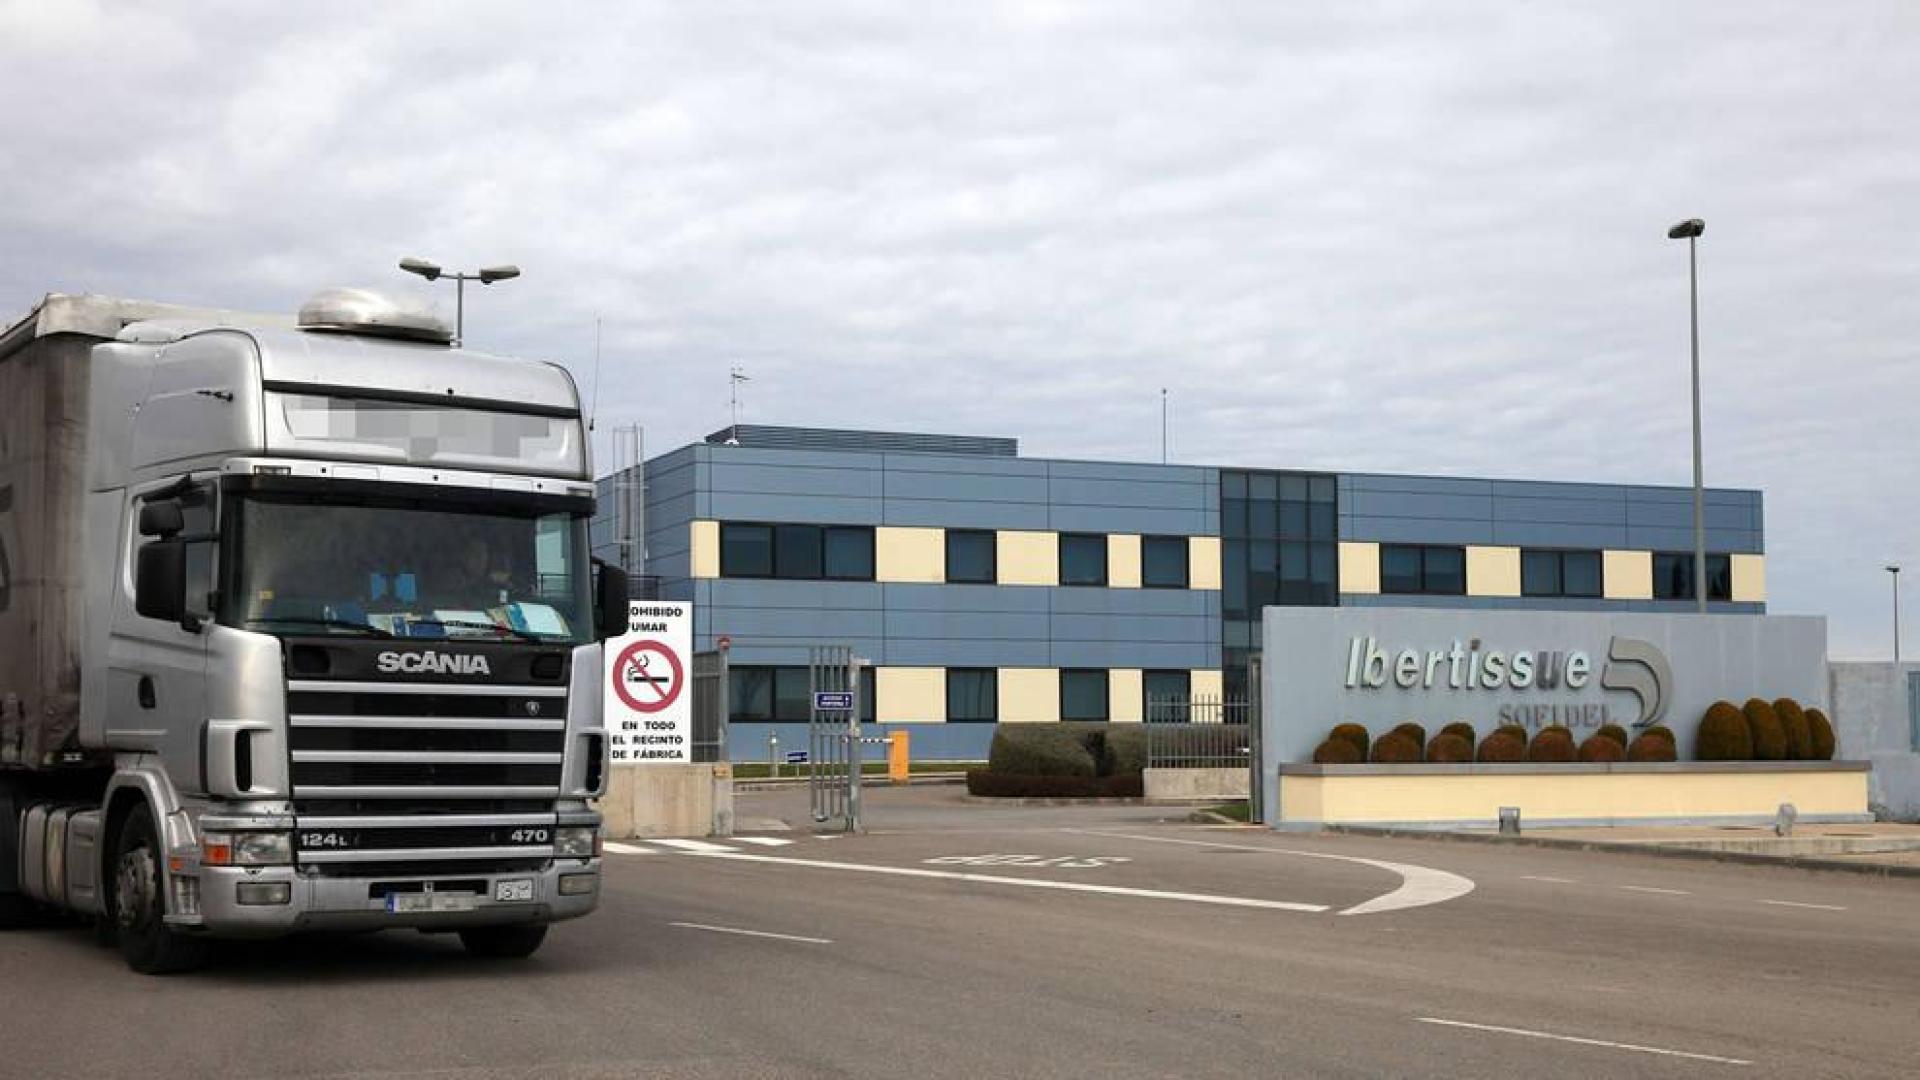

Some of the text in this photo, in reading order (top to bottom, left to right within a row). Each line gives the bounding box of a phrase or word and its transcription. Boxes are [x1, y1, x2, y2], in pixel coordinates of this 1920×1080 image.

[630, 606, 683, 617] OHIBIDO
[631, 622, 668, 632] UMAR
[377, 650, 491, 674] SCANIA
[1344, 637, 1591, 690] Ibertissue
[1499, 703, 1618, 728] SOFIDEL
[622, 720, 676, 730] EN TODO
[612, 735, 683, 745] EL RECINTO
[612, 749, 627, 758] DE
[511, 829, 548, 842] 470
